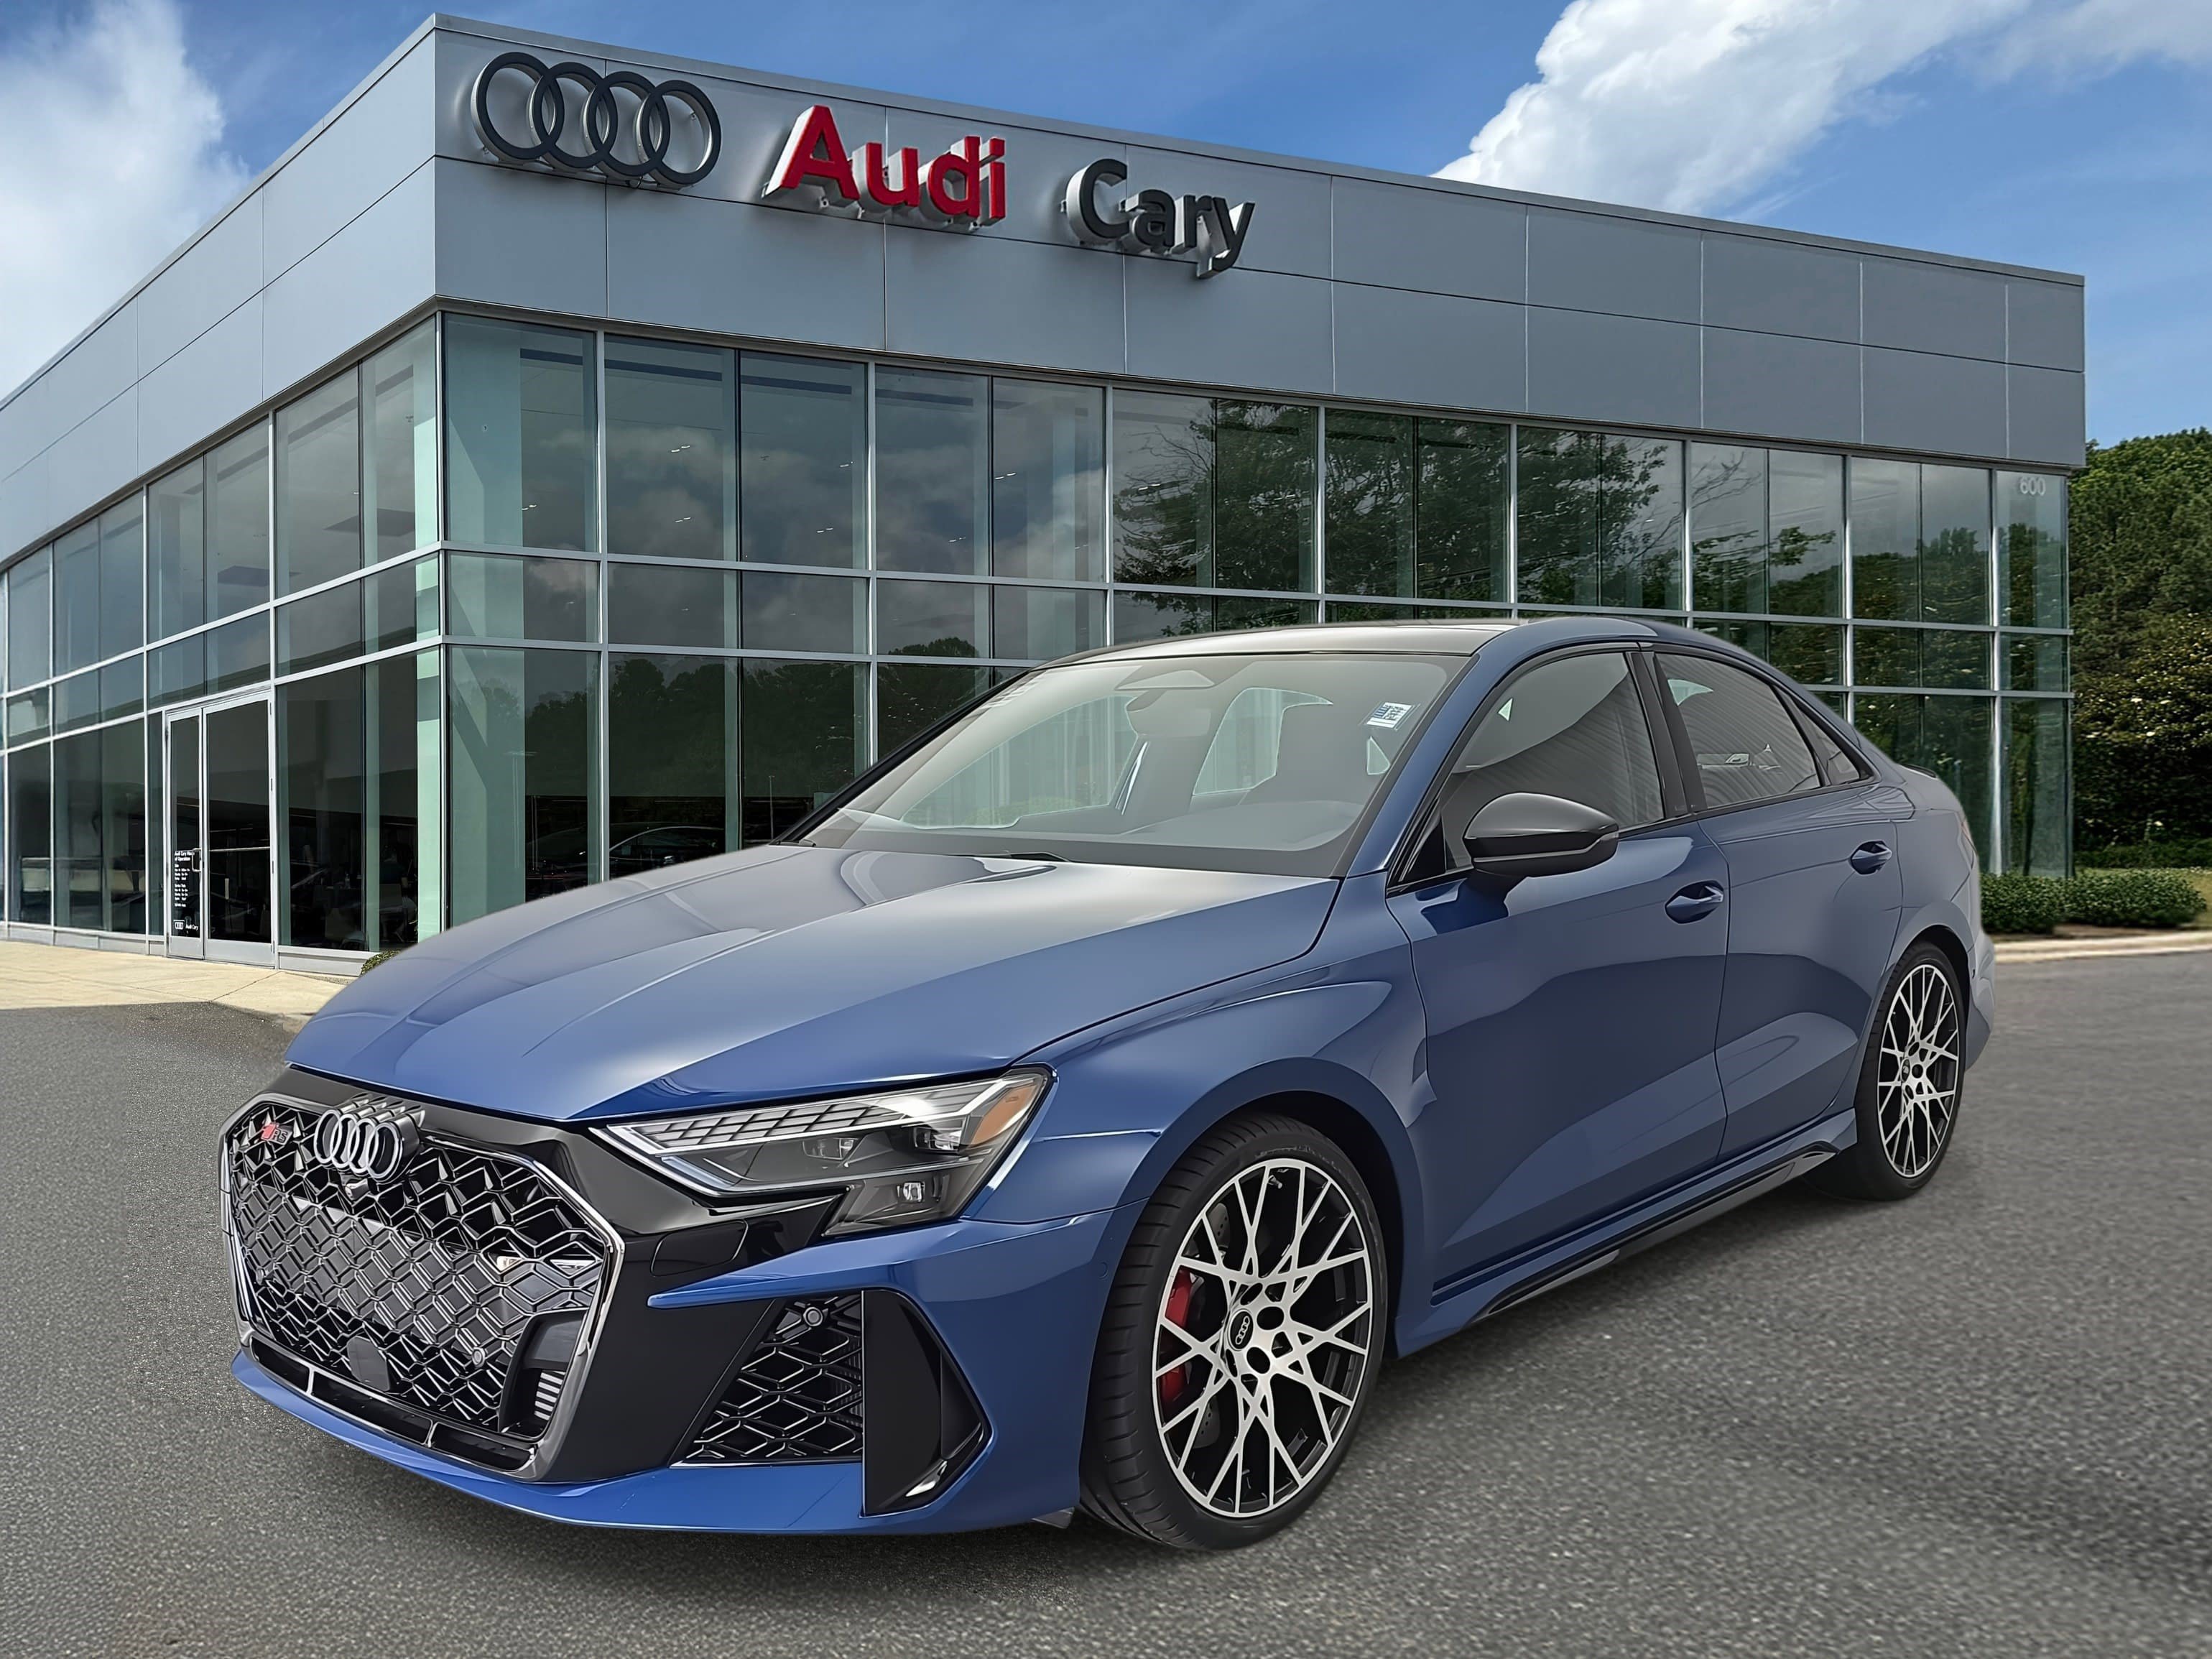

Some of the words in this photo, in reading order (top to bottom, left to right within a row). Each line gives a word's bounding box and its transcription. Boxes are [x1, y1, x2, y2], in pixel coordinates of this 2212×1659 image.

[767, 105, 1006, 226] Audi
[1065, 158, 1255, 277] Cary
[2020, 476, 2046, 496] 600
